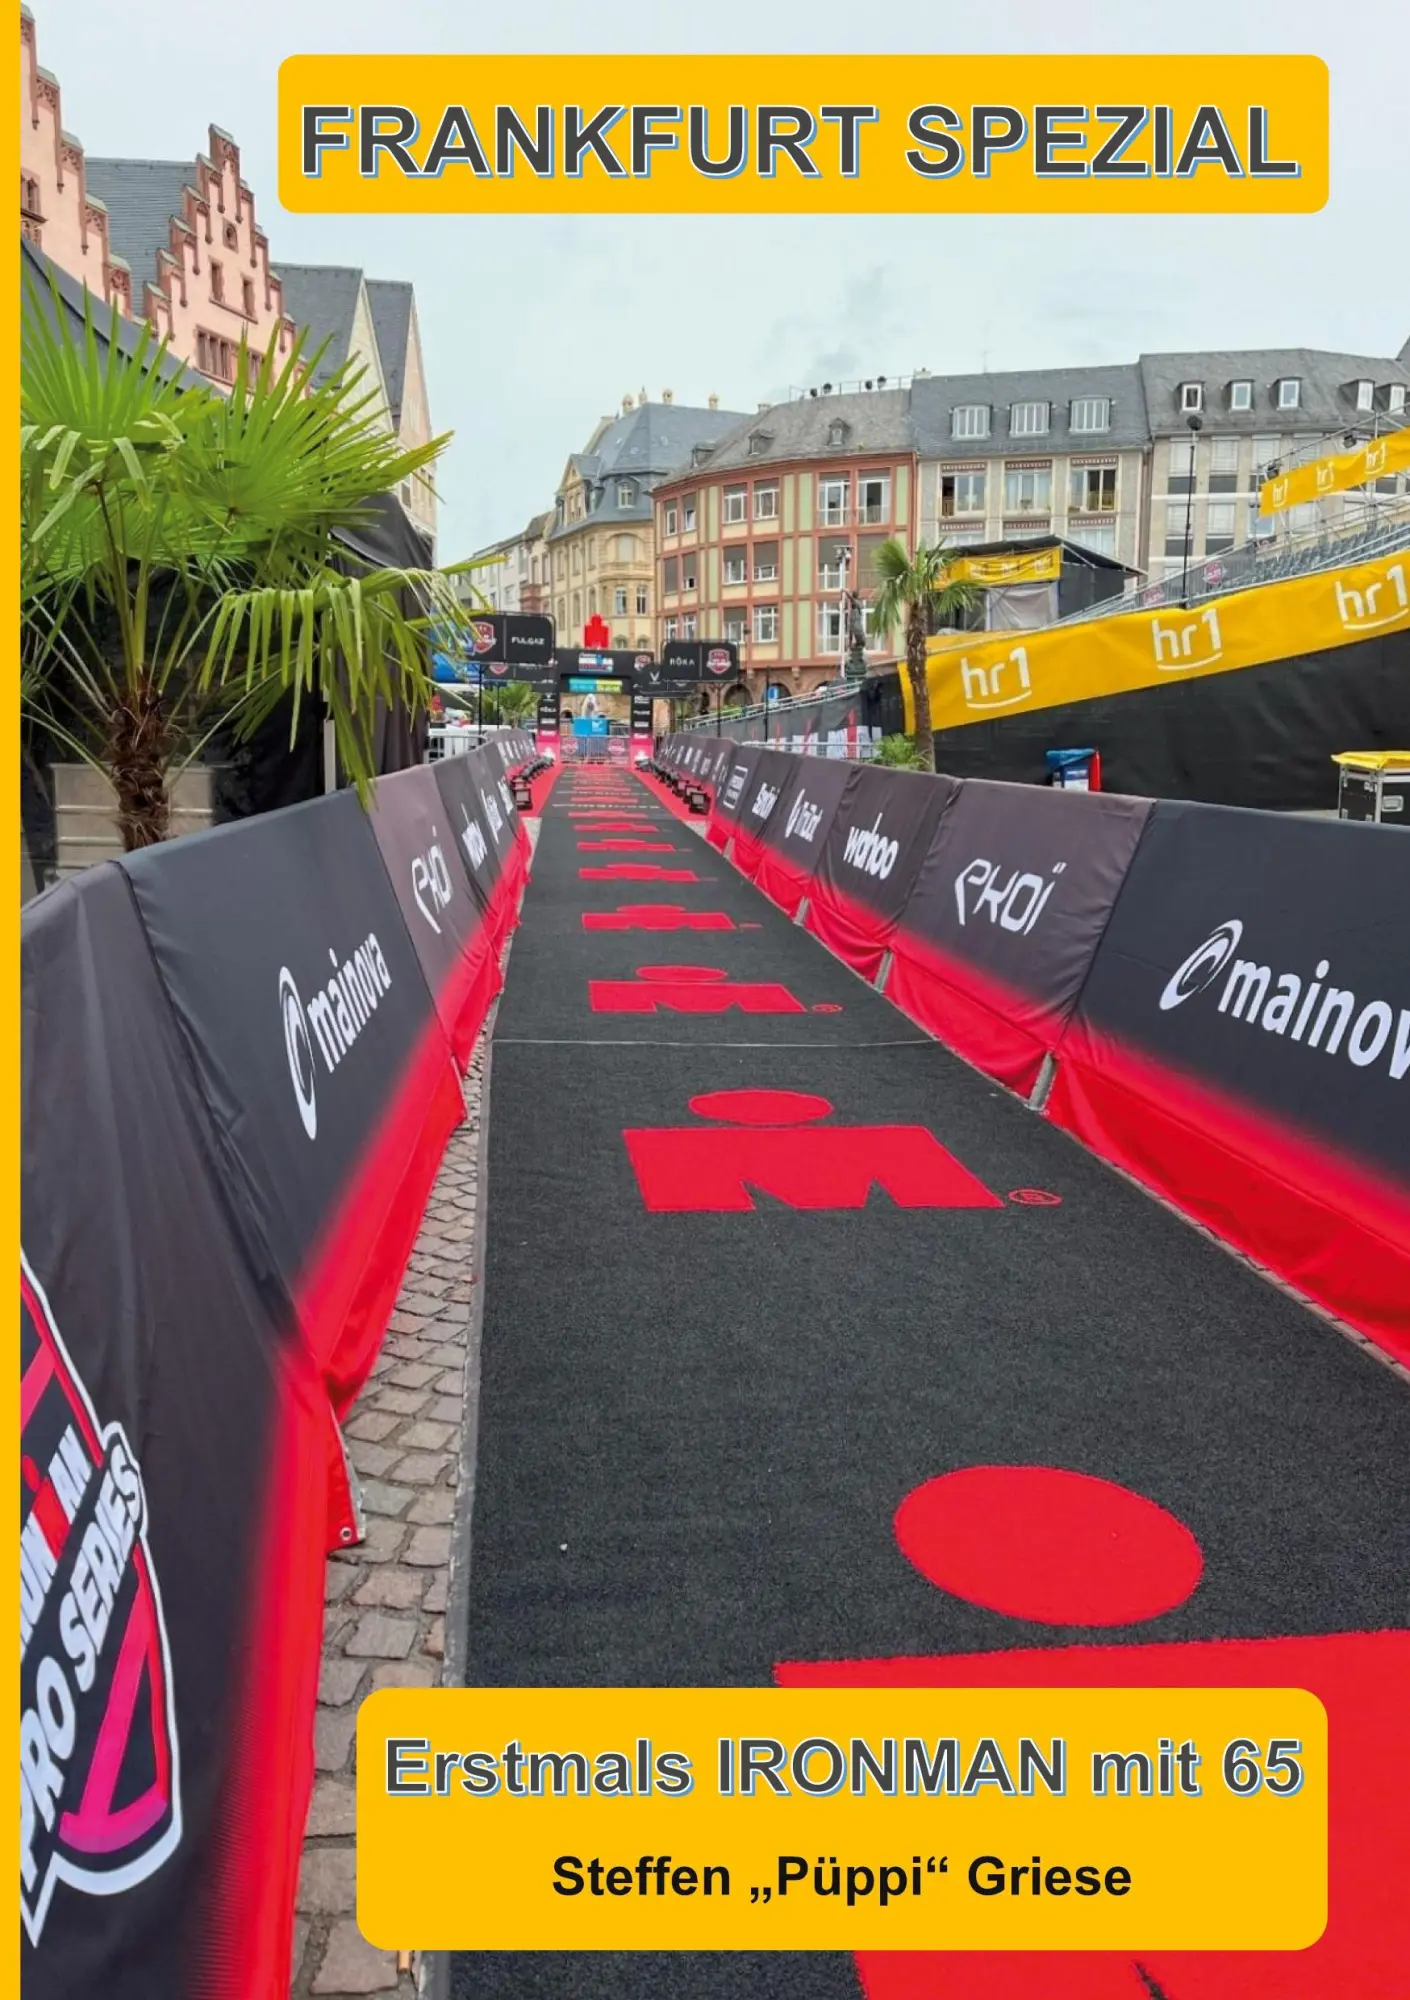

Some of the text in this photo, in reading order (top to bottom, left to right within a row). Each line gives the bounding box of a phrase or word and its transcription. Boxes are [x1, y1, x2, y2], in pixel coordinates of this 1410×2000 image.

[1335, 564, 1408, 626] hr1
[1151, 608, 1223, 664] hr1
[961, 647, 1031, 702] hr1
[843, 812, 899, 880] wahoo
[307, 932, 393, 1074] mainova
[60, 1444, 141, 1692] SERIES
